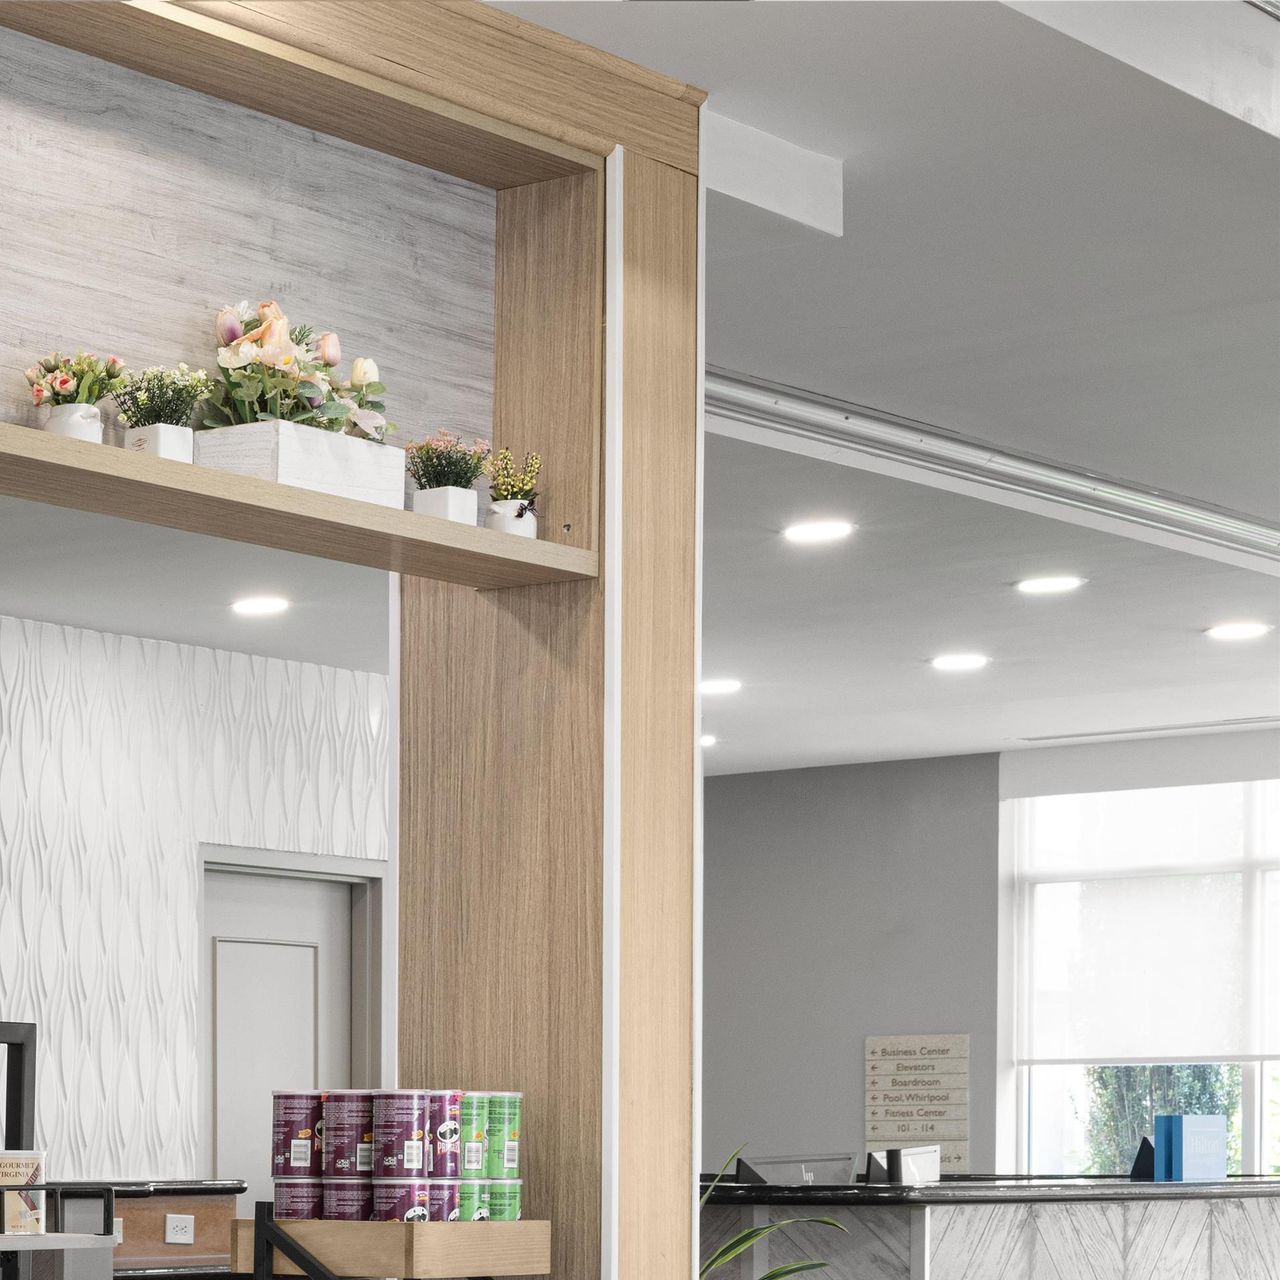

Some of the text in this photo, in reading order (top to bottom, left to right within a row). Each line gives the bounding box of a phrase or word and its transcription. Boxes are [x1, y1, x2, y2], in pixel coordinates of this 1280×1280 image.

[881, 1046, 950, 1057] Business Center
[896, 1063, 936, 1072] Elevators
[891, 1078, 941, 1087] Boardroom
[905, 1092, 950, 1102] Whirlpool
[884, 1108, 947, 1118] Fitness Center
[897, 1123, 910, 1132] 101
[921, 1123, 935, 1132] 114
[0, 1161, 35, 1169] GOURMET
